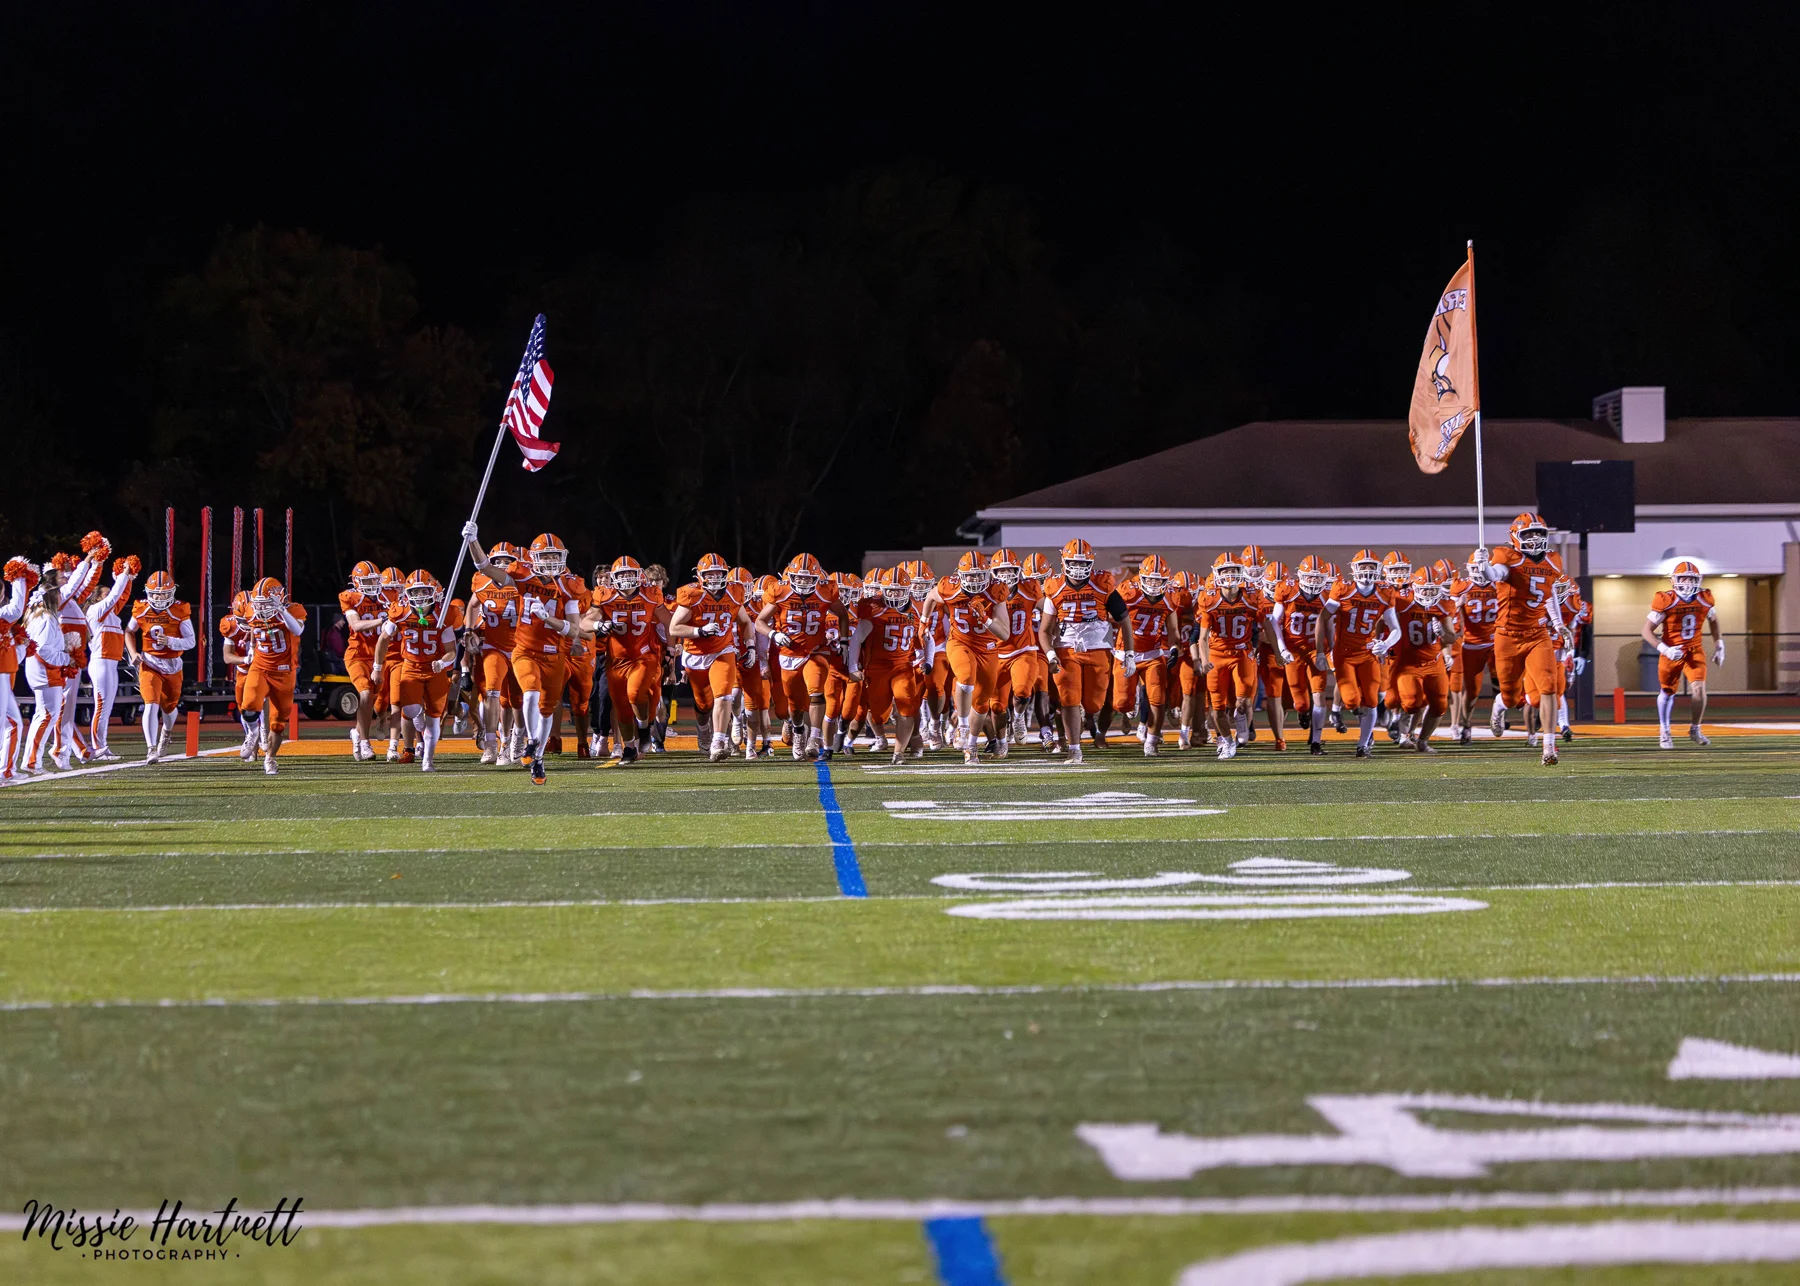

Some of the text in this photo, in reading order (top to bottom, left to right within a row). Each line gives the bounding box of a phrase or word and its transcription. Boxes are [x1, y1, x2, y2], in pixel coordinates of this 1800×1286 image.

[486, 591, 515, 599] VIKINGS
[1526, 575, 1546, 608] 5
[483, 599, 518, 628] 64
[612, 610, 647, 636] 55
[787, 610, 821, 636] 56
[1062, 600, 1098, 622] 75
[1290, 611, 1319, 636] 82
[1346, 607, 1379, 635] 15
[1467, 598, 1499, 623] 32
[150, 625, 165, 651] 9
[884, 624, 915, 652] 50
[1217, 615, 1247, 639] 16
[1680, 613, 1697, 640] 8
[253, 628, 287, 653] 20
[404, 629, 438, 655] 25
